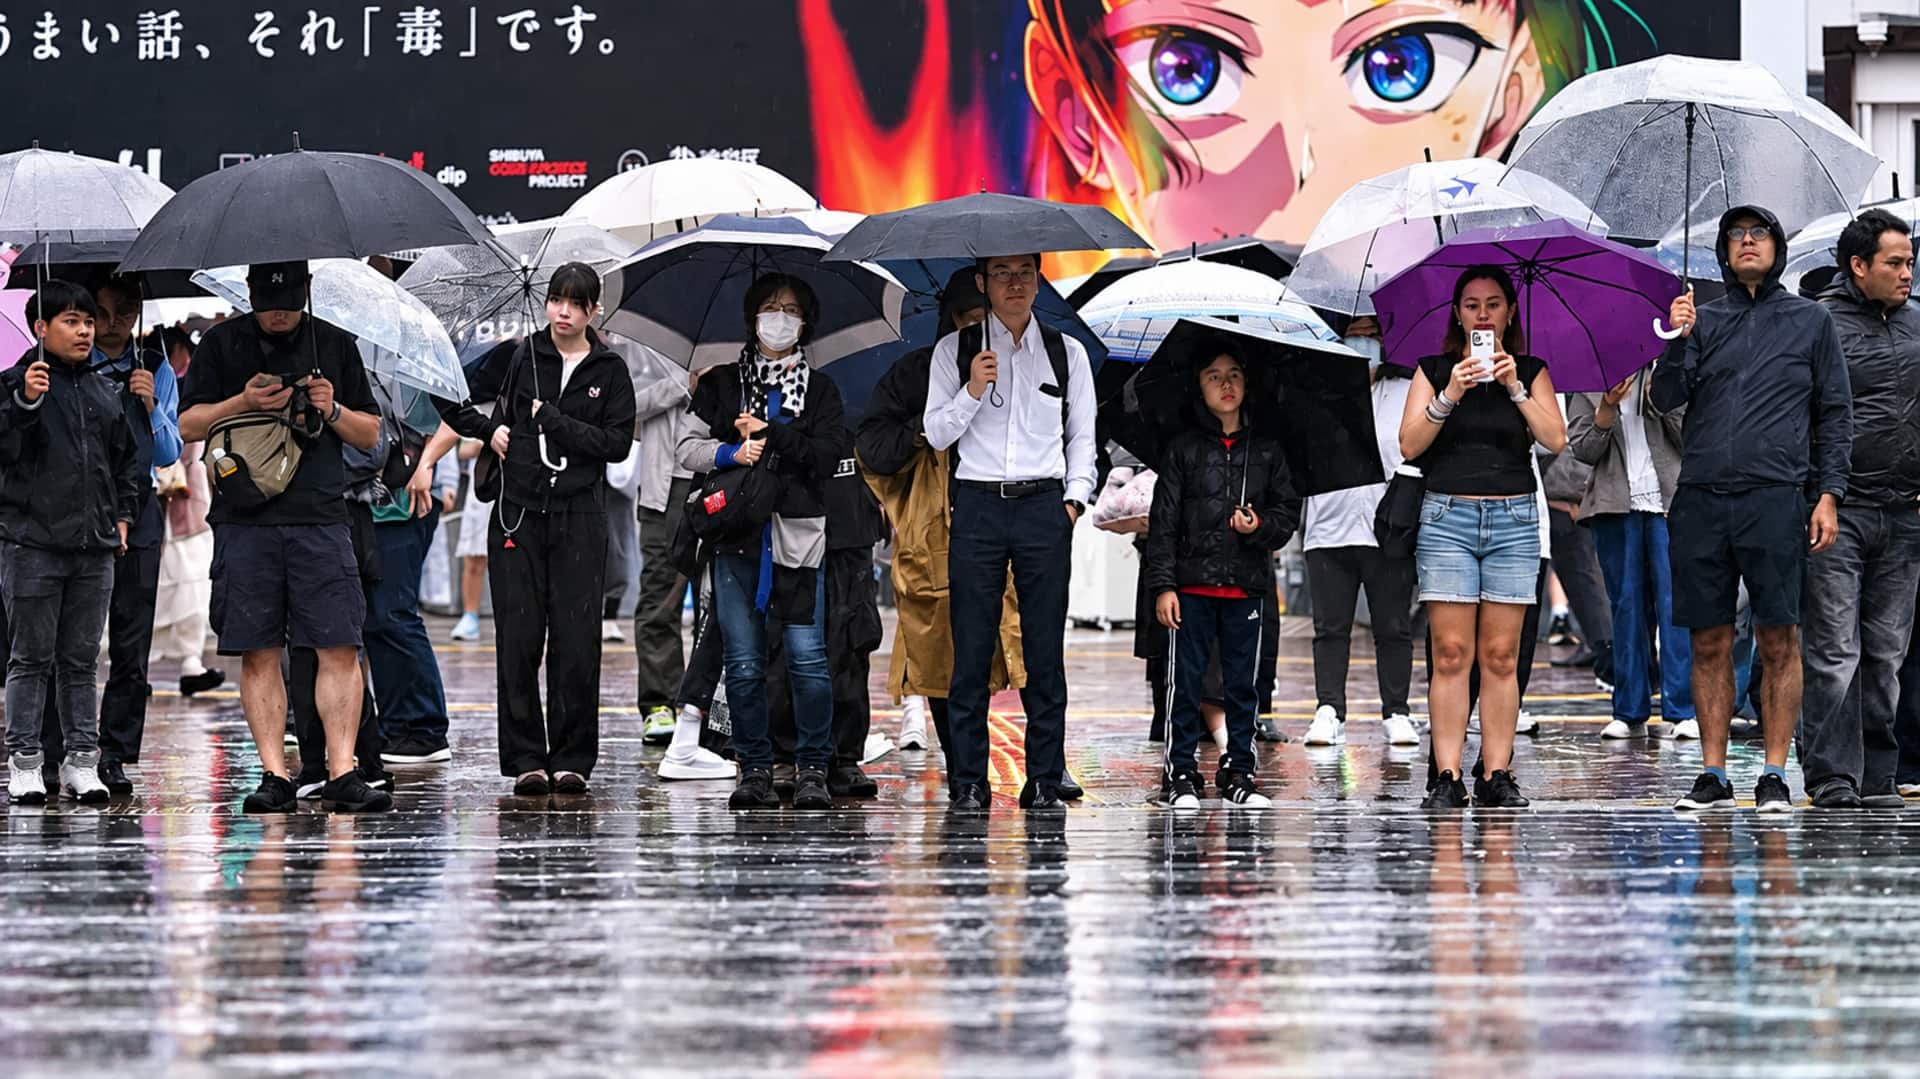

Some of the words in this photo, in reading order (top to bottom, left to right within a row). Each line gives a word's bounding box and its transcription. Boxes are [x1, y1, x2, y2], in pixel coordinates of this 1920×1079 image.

[489, 149, 545, 162] SHIBUYA
[436, 165, 467, 188] dip
[529, 174, 587, 188] PROJECT
